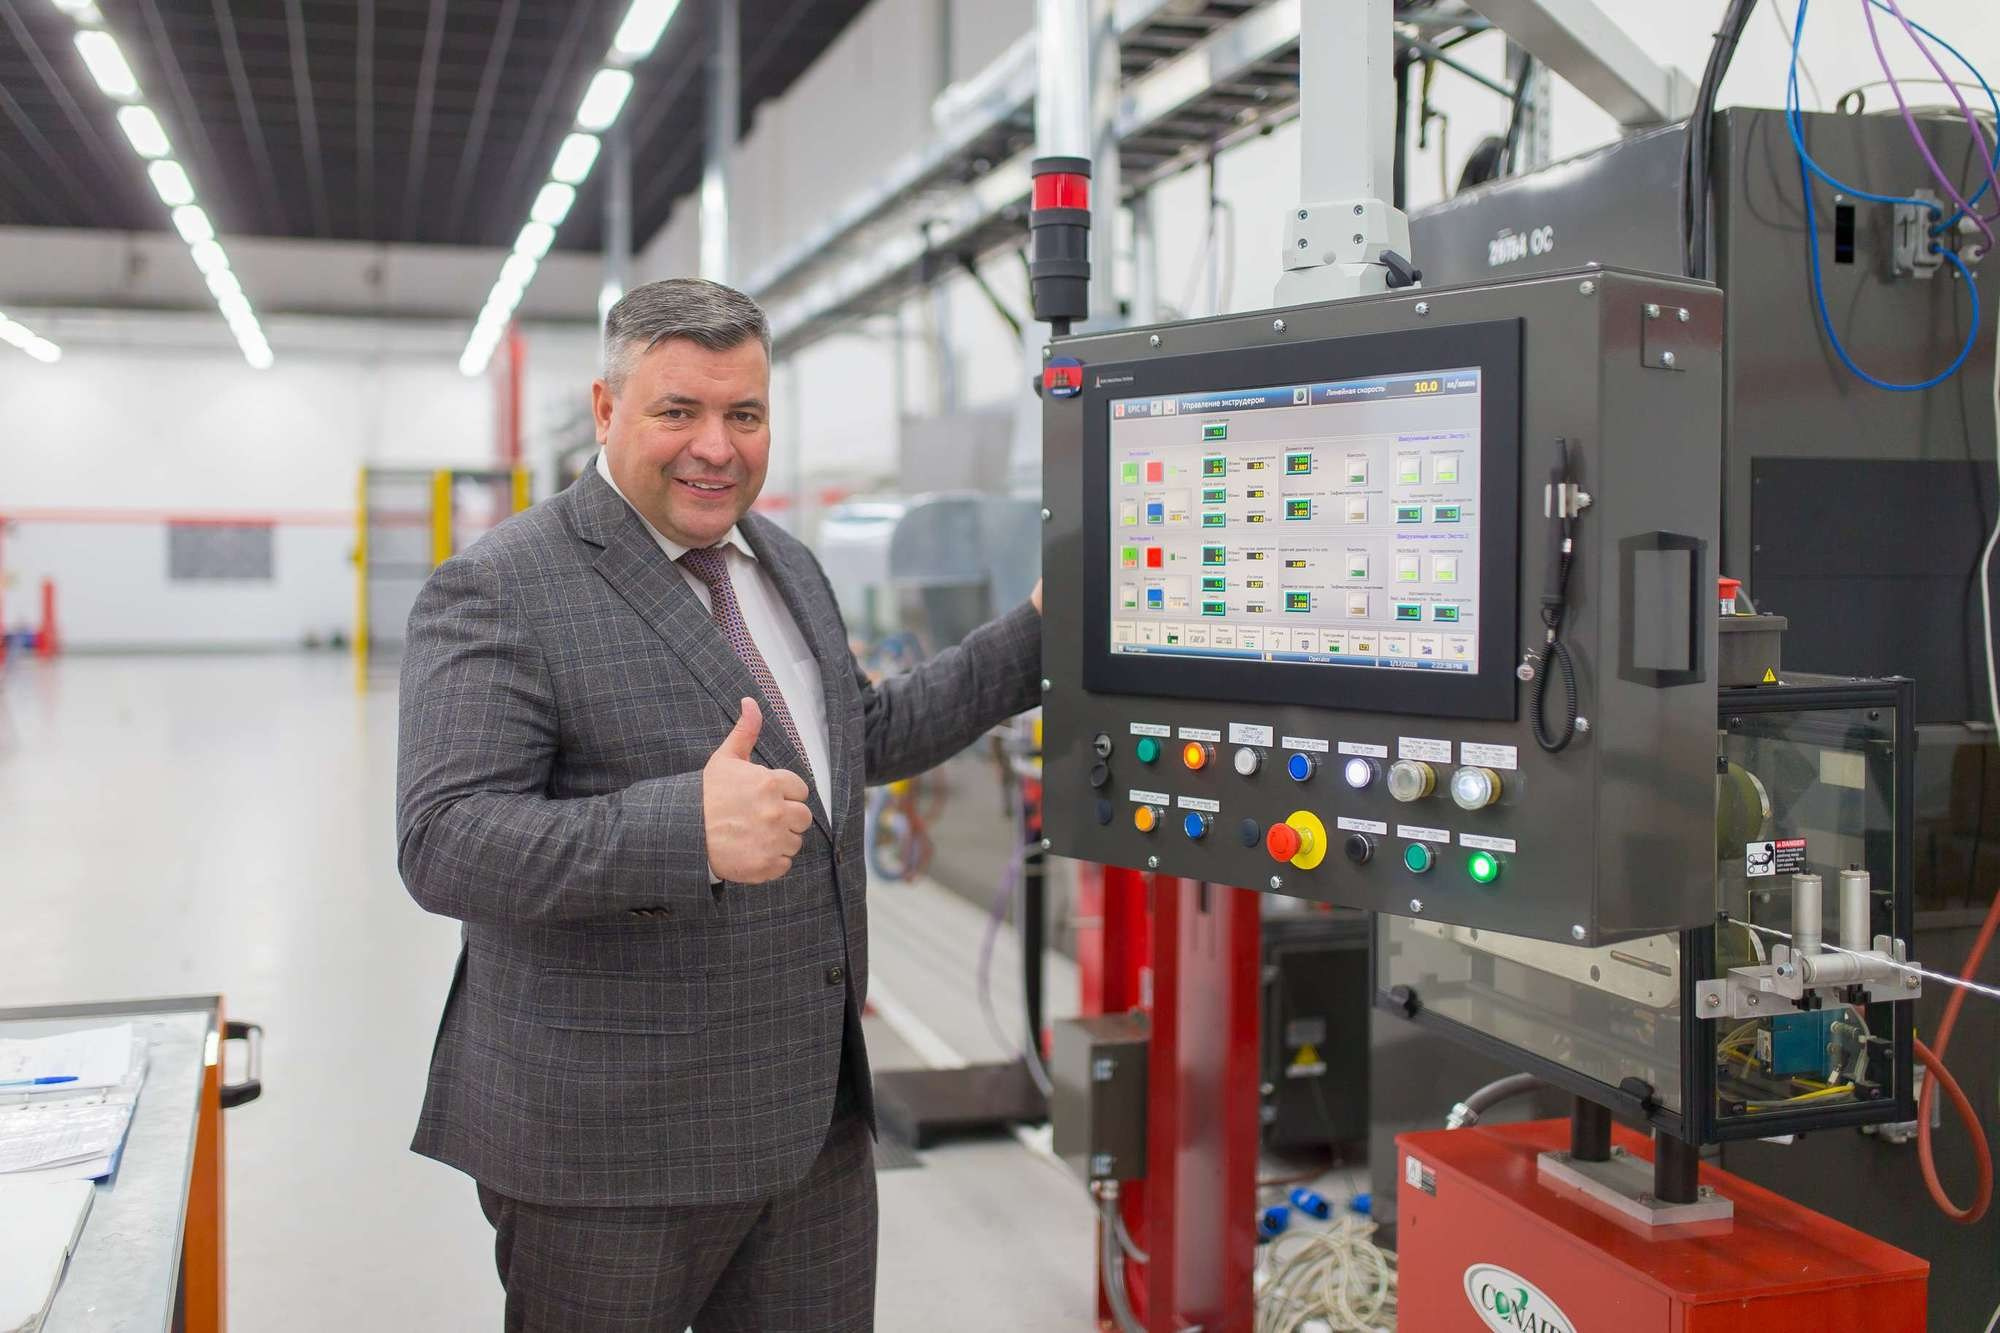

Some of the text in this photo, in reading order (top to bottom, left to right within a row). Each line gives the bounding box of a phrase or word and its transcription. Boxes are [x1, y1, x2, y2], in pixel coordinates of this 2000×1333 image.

[1326, 386, 1386, 396] Линейная скорость
[1414, 380, 1438, 393] 10.0
[1182, 397, 1265, 410] Управление экструдером
[1781, 839, 1805, 848] DANGER
